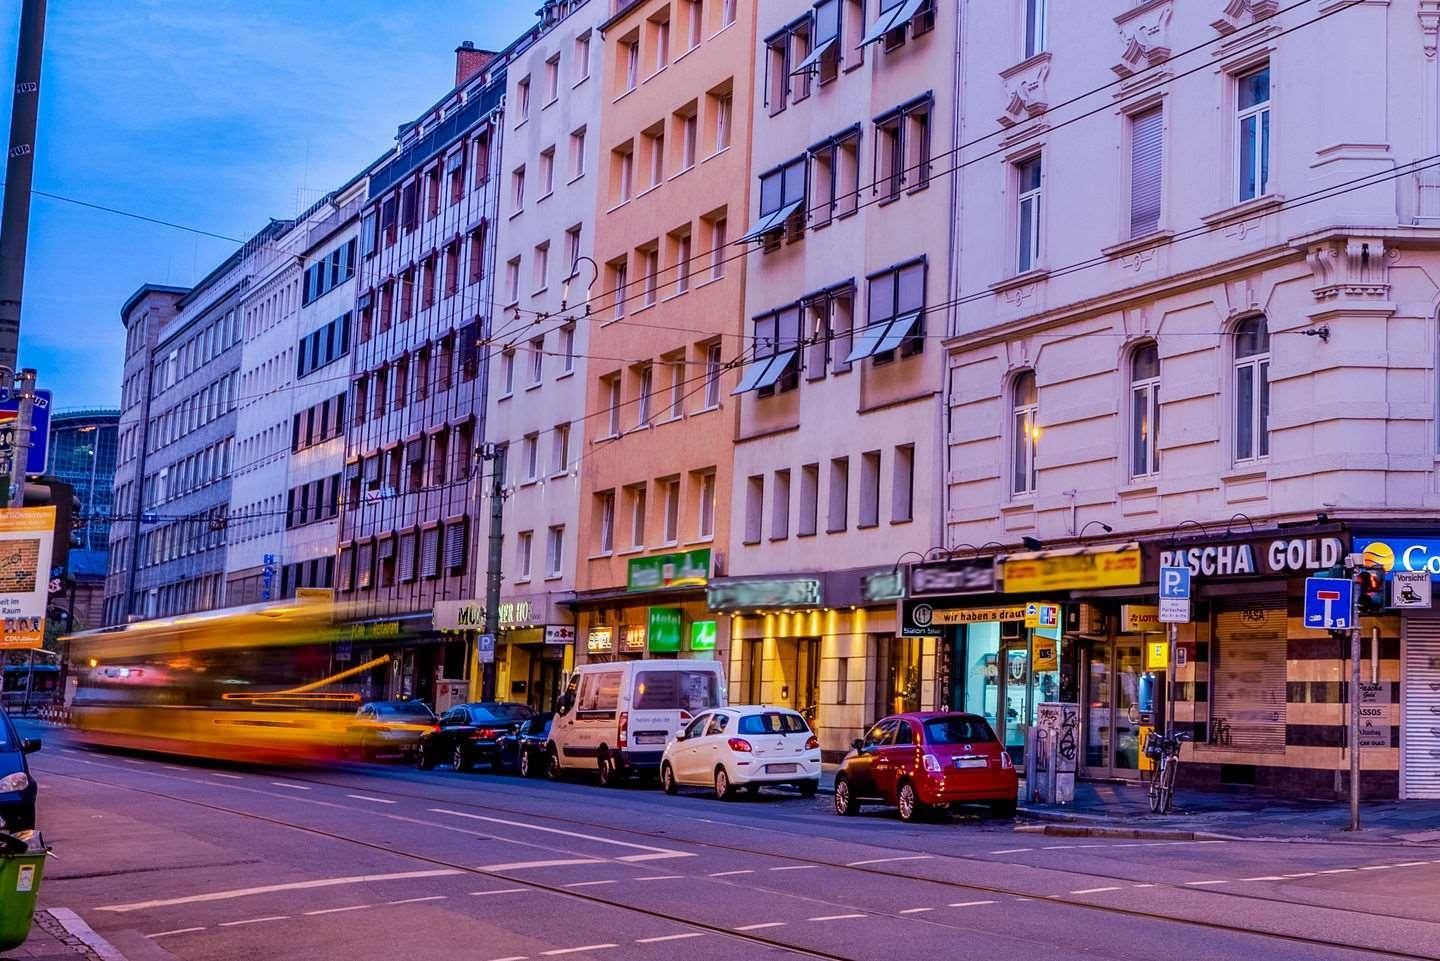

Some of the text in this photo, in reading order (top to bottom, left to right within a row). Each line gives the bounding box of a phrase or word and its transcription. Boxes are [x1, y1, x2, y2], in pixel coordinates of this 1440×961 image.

[1268, 538, 1342, 571] GOLD
[1397, 573, 1427, 582] Vorsicht!
[943, 613, 958, 622] wir
[960, 611, 988, 621] haben
